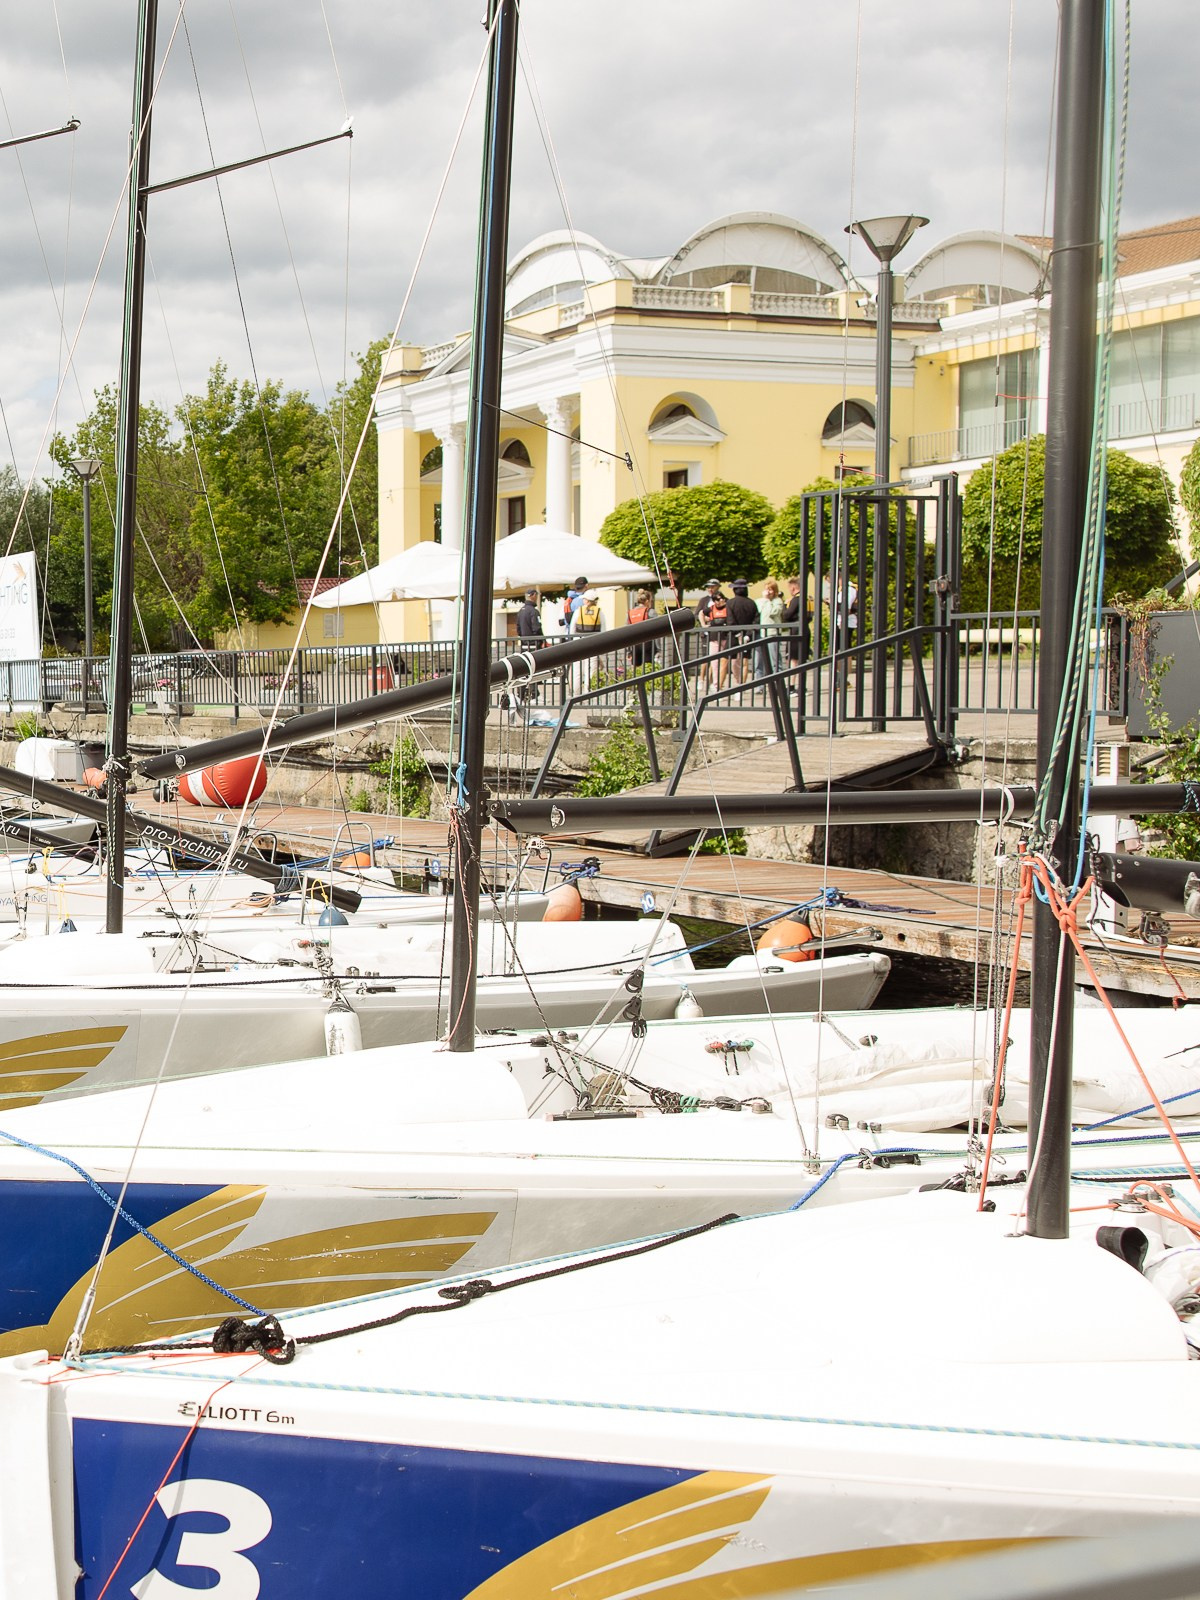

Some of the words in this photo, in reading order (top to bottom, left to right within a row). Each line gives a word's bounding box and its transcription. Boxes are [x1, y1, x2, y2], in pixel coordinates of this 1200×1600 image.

[141, 825, 249, 870] pro-yachtin.ru
[178, 1401, 262, 1422] ELLIOTT
[266, 1410, 295, 1425] 6m
[129, 1478, 273, 1600] 3
